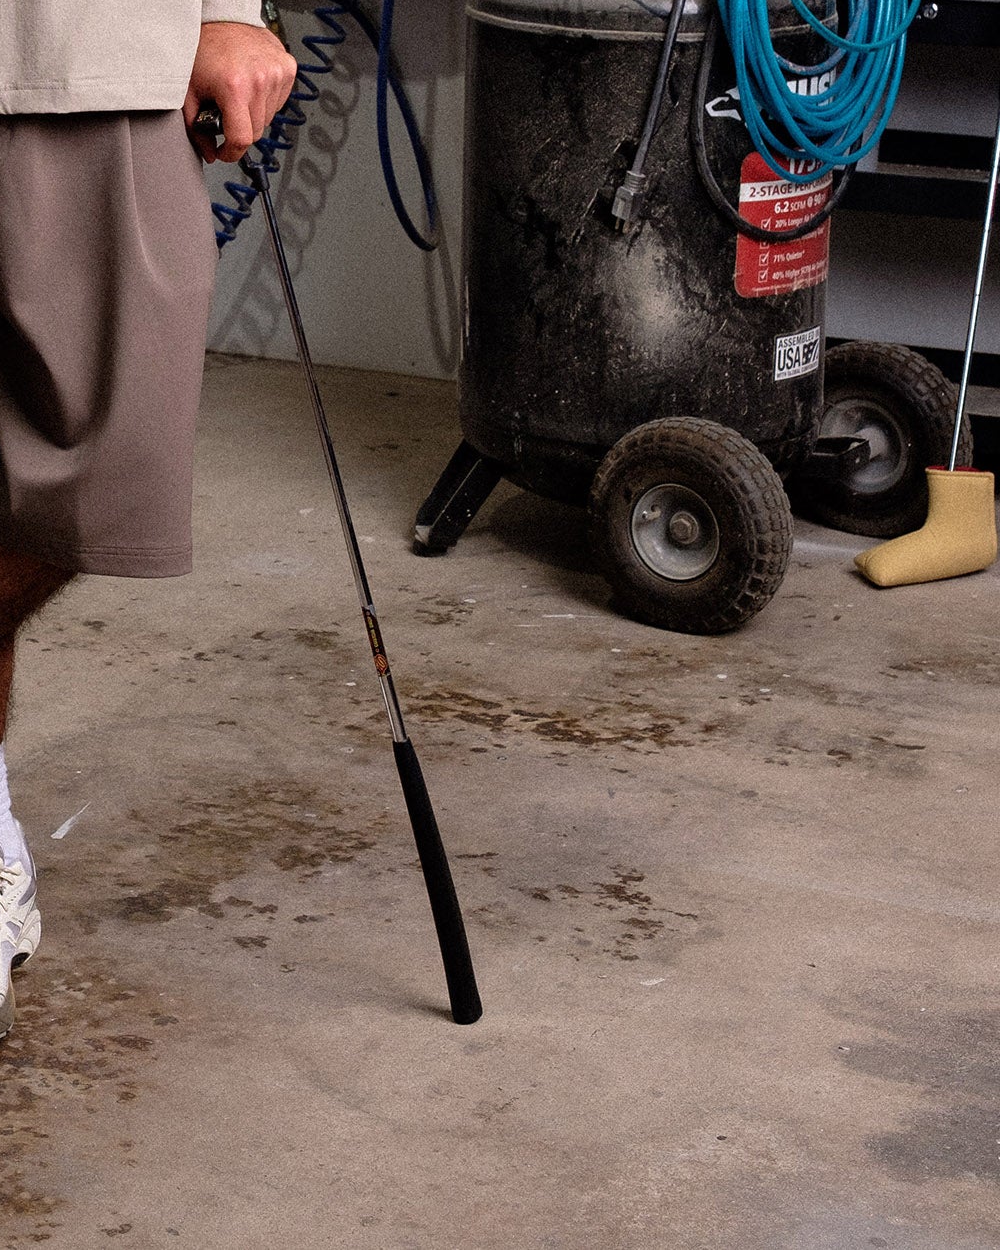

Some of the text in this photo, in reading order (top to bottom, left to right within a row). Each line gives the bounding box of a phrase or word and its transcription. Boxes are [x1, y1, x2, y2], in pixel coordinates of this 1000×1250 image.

[749, 183, 793, 198] 2-STAGE
[774, 200, 790, 214] 6.2
[778, 345, 801, 372] USA
